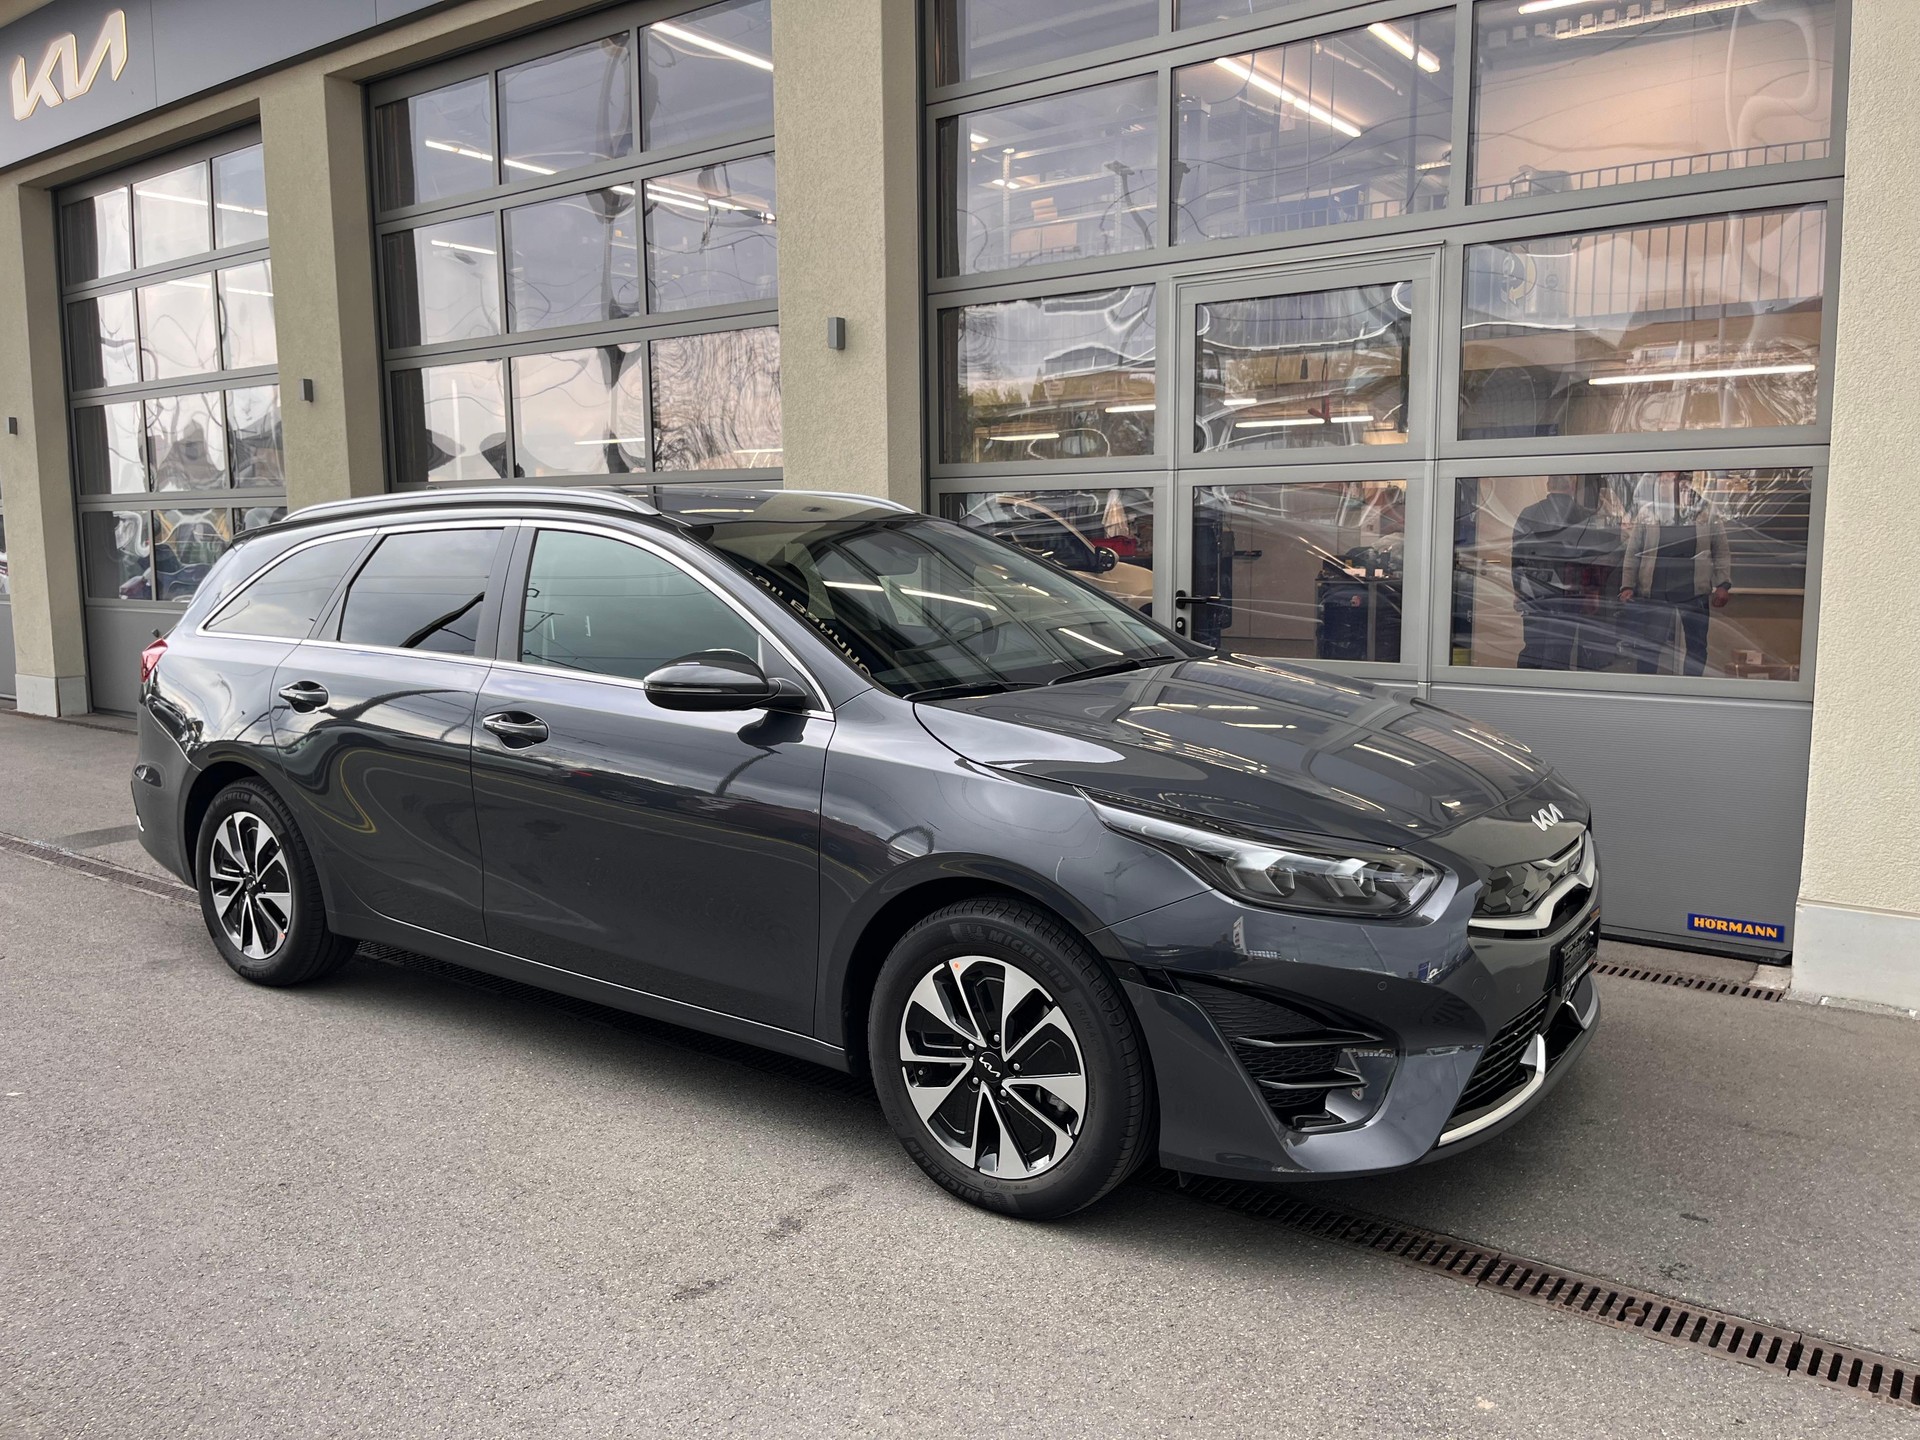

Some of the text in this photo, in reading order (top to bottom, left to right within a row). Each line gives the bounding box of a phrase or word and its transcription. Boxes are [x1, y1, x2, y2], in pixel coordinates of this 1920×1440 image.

[11, 8, 128, 121] KIA
[1530, 802, 1564, 831] KIA
[1693, 917, 1778, 938] HÖRMANN
[988, 929, 1071, 989] MICHELIN
[905, 1140, 981, 1201] MICHELIN
